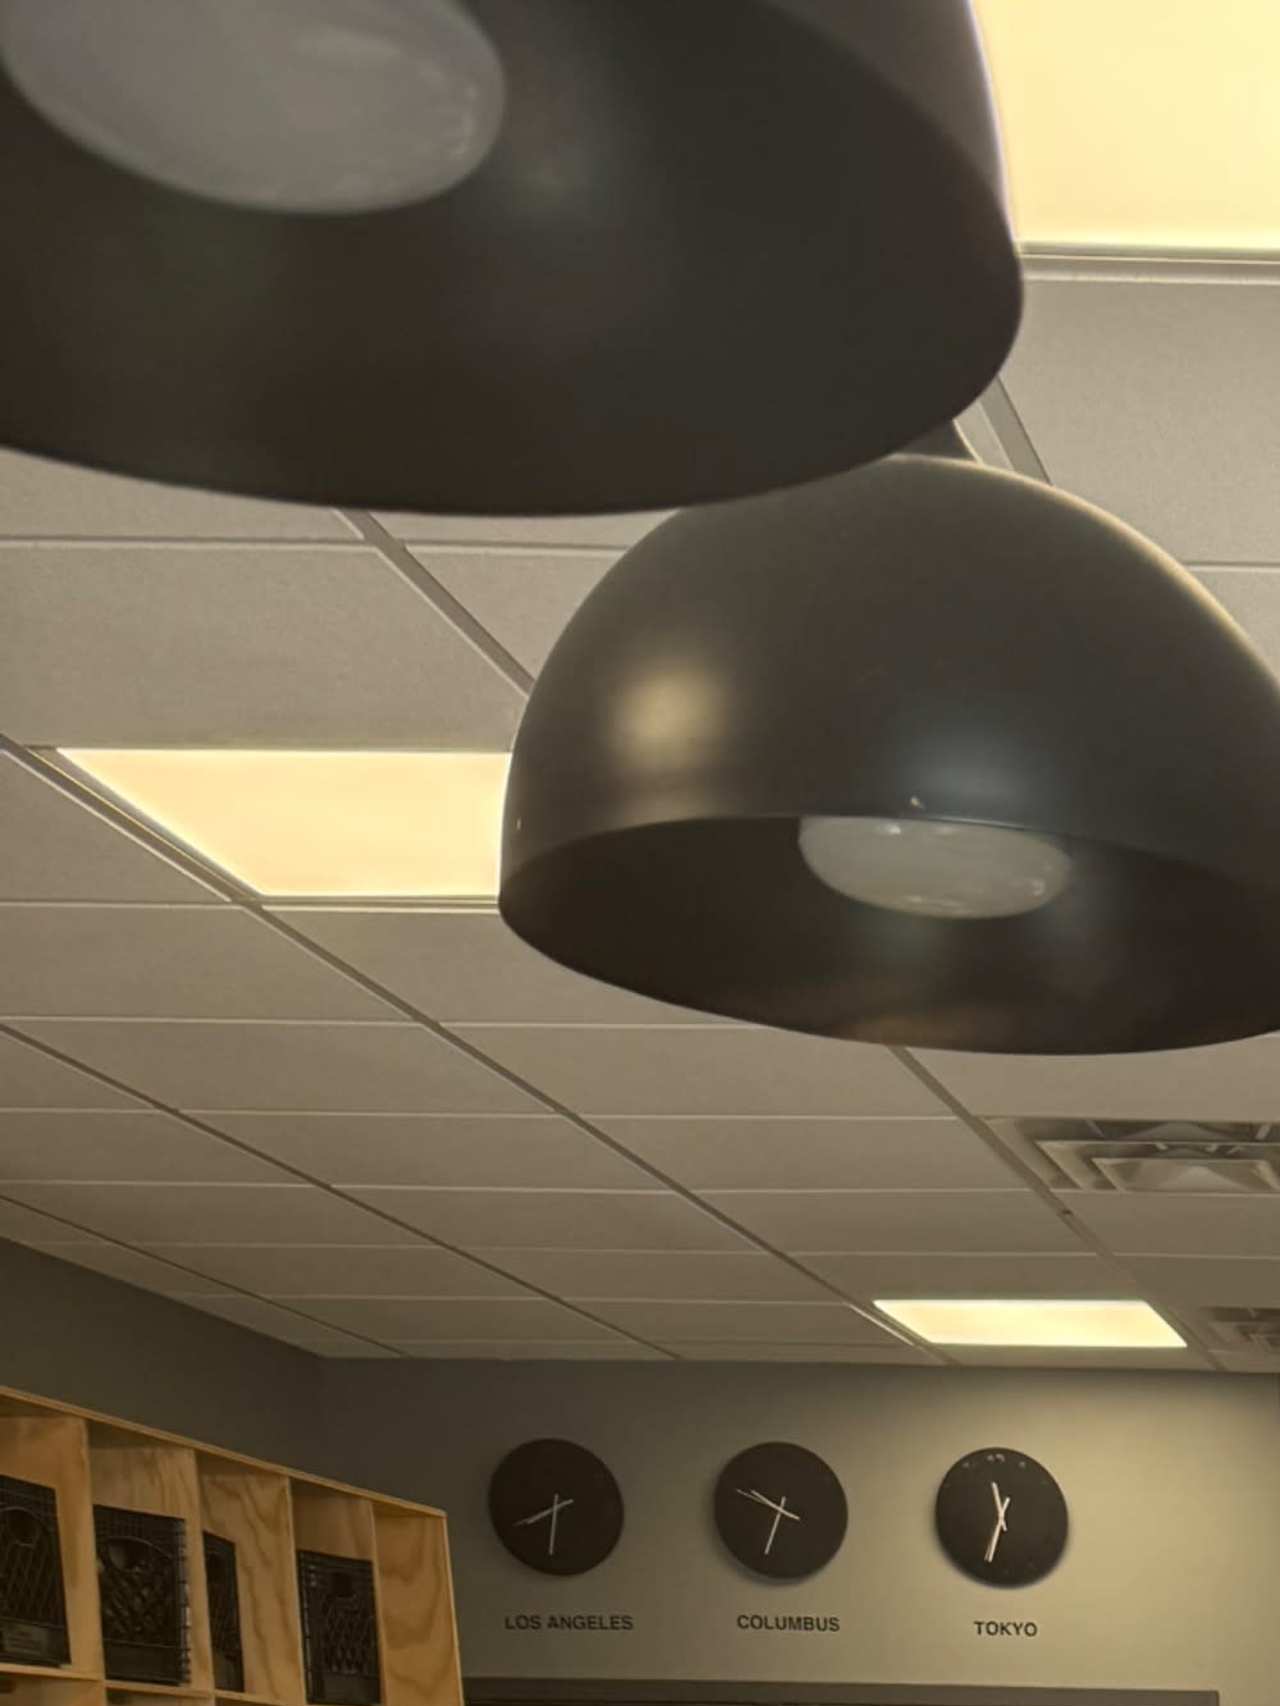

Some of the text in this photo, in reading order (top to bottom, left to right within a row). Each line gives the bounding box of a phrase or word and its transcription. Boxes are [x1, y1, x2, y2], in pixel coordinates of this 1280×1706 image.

[505, 1614, 634, 1632] LOS ANGELES
[736, 1614, 841, 1634] COLUMBUS
[973, 1620, 1039, 1639] TOKYO
